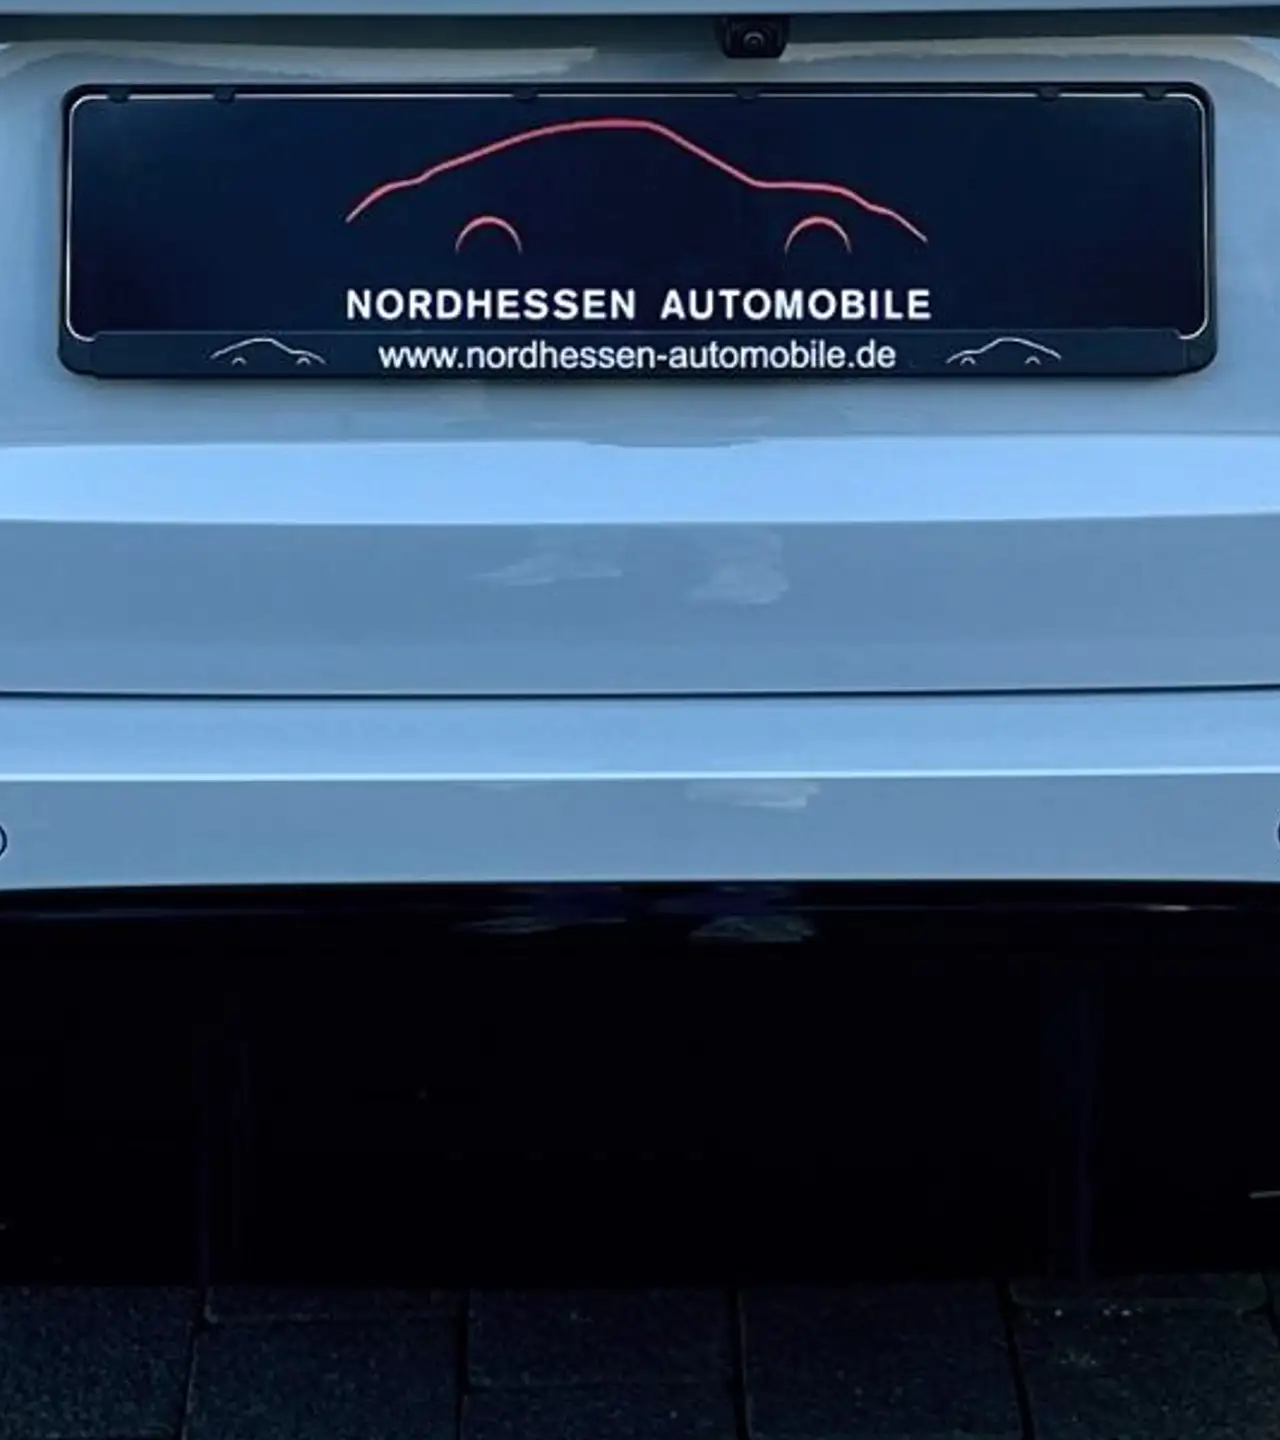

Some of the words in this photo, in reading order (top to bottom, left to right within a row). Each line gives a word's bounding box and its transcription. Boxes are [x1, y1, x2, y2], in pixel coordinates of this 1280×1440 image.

[346, 288, 636, 321] NORDHESSEN
[660, 288, 932, 321] AUTOMOBILE
[378, 339, 897, 370] www.nordhessen-automobile.de
